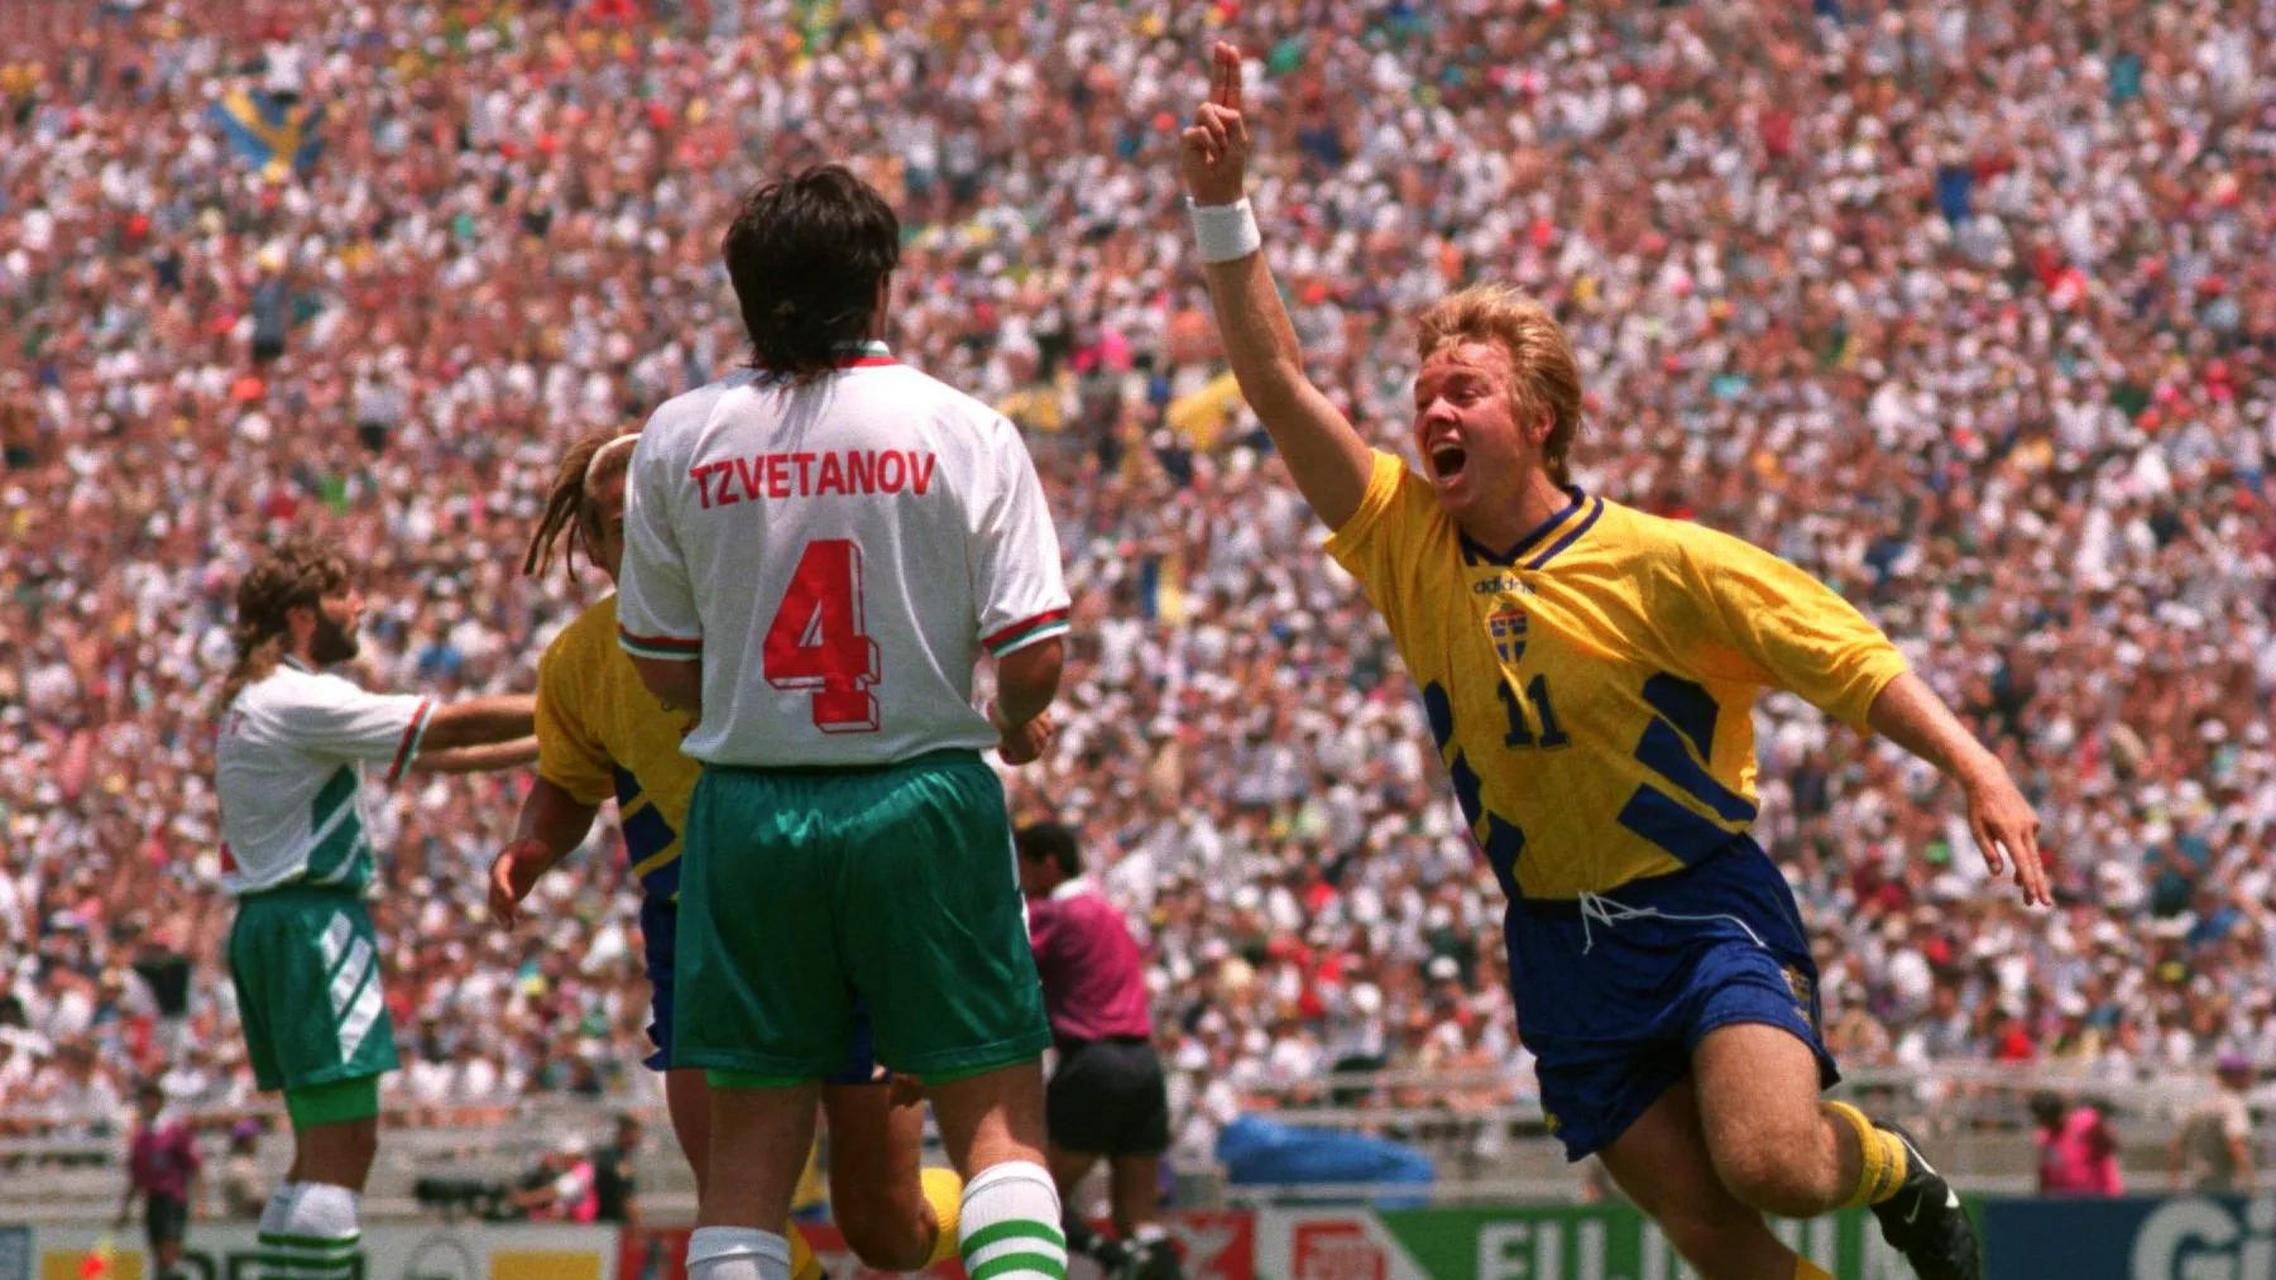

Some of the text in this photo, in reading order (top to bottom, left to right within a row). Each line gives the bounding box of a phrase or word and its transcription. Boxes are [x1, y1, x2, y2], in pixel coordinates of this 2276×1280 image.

[689, 449, 936, 510] TZVETANOV
[763, 538, 881, 734] 4
[1497, 673, 1572, 748] 11
